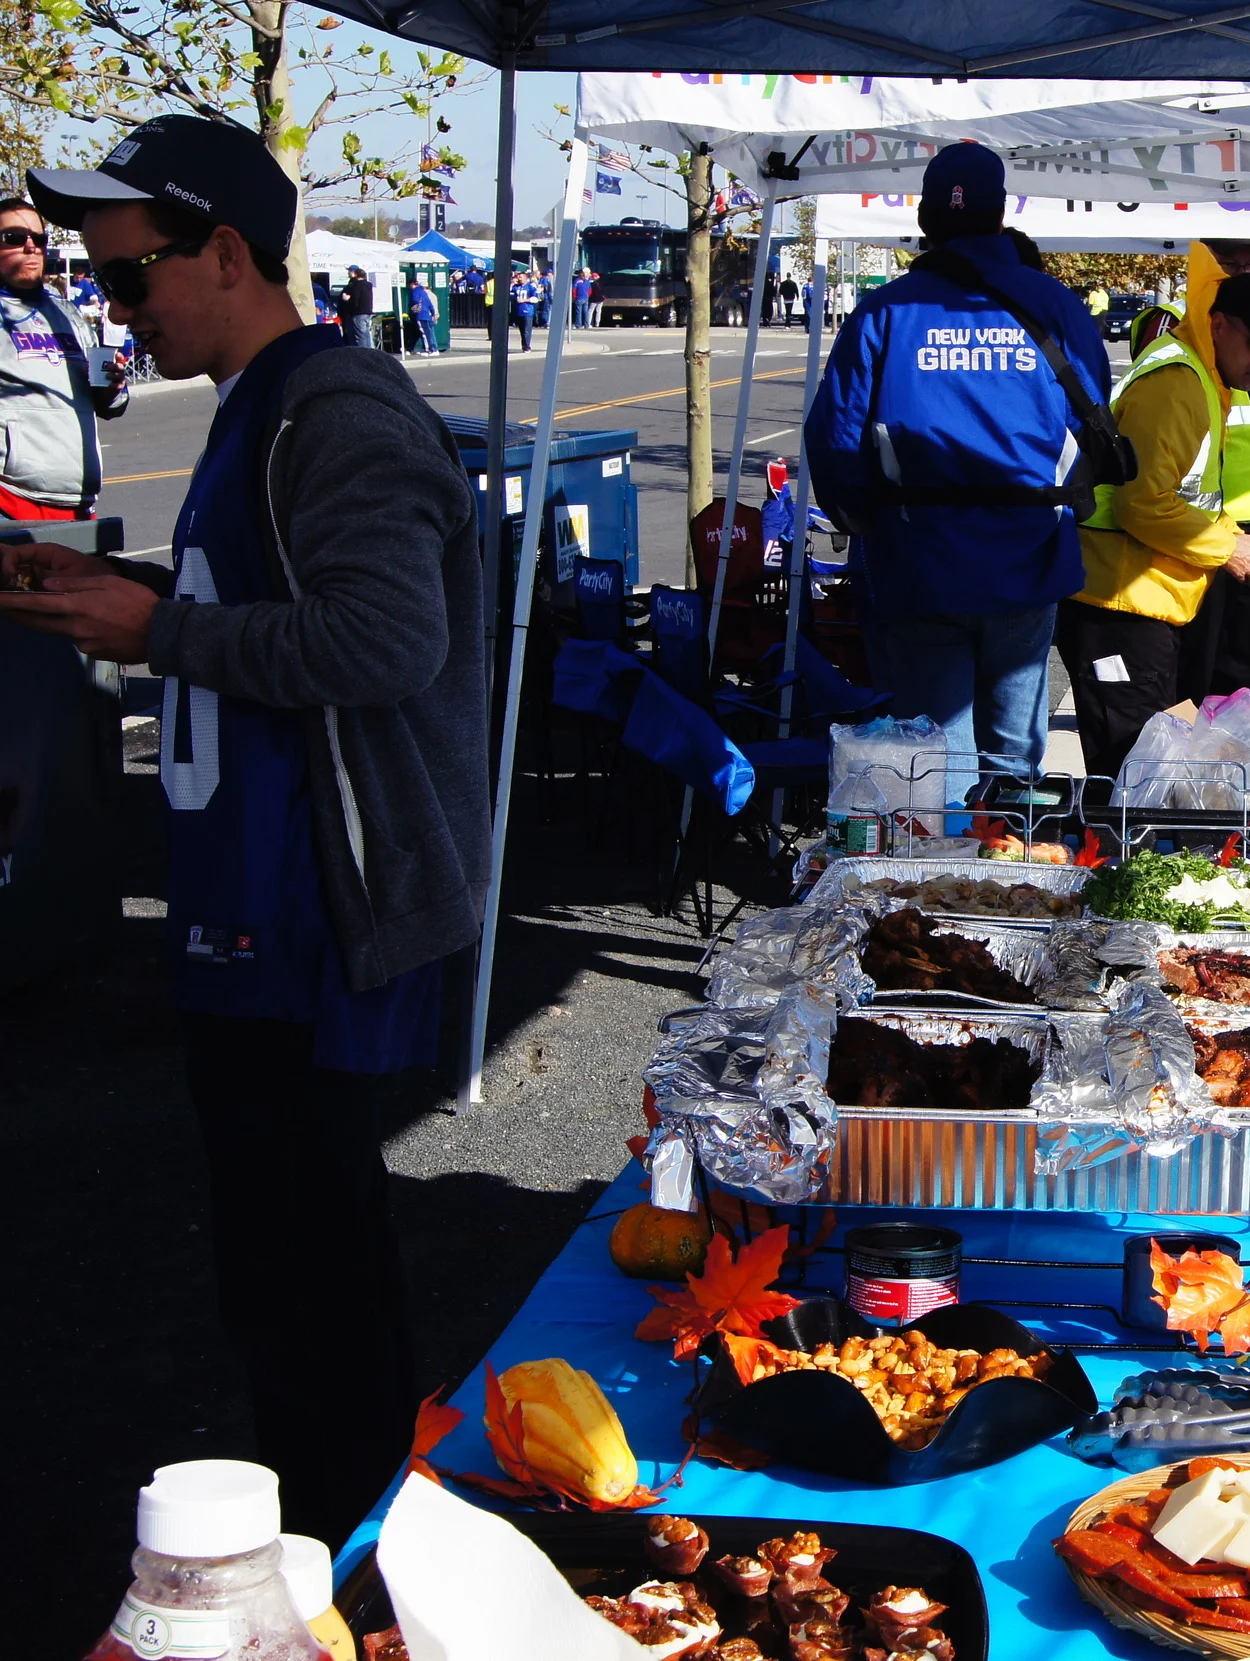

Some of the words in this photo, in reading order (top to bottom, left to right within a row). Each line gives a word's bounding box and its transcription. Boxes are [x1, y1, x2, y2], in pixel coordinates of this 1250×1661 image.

[165, 182, 213, 212] Reebok
[927, 328, 970, 345] NEW
[975, 328, 1025, 345] YORK
[917, 347, 1037, 371] GIANTS
[146, 1619, 156, 1634] 3
[139, 1634, 160, 1646] PACK
